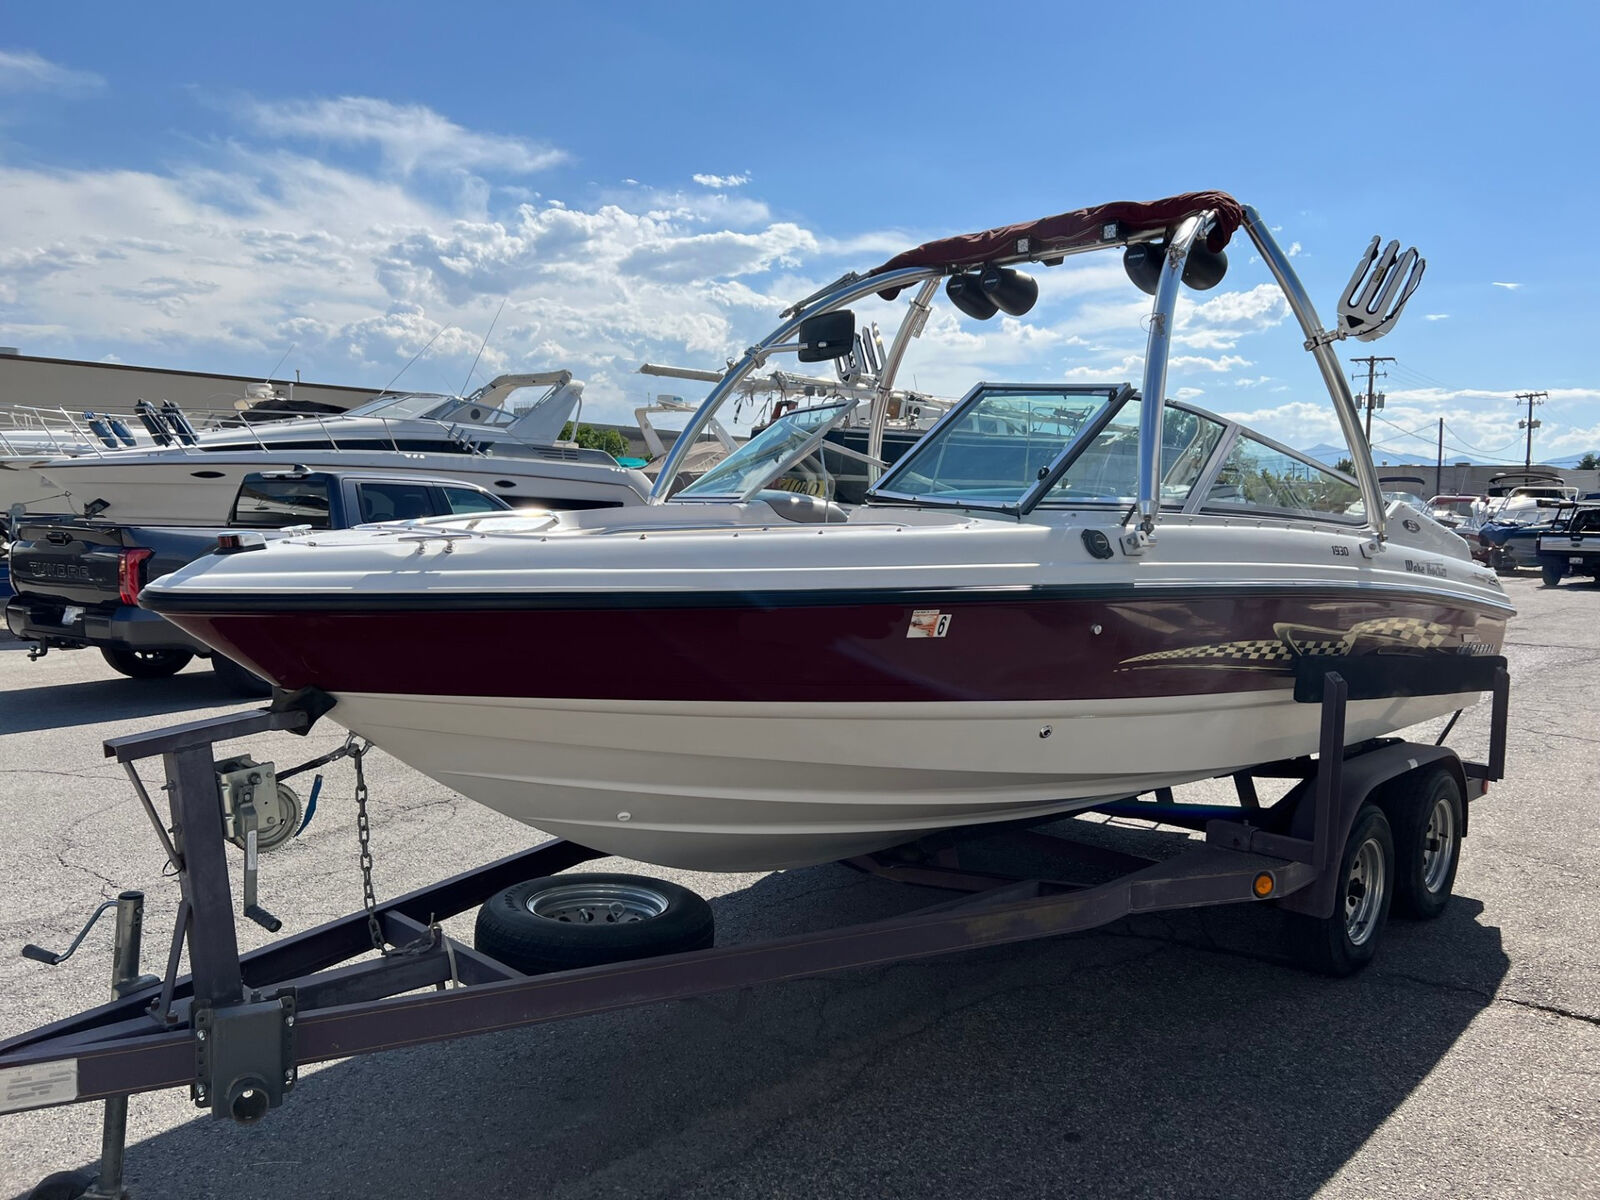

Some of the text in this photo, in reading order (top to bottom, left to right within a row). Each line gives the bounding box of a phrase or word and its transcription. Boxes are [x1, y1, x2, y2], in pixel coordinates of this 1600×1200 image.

[1331, 545, 1349, 556] 1930
[29, 561, 89, 578] TUNDRA
[1405, 559, 1425, 574] Wake
[937, 615, 948, 636] 6
